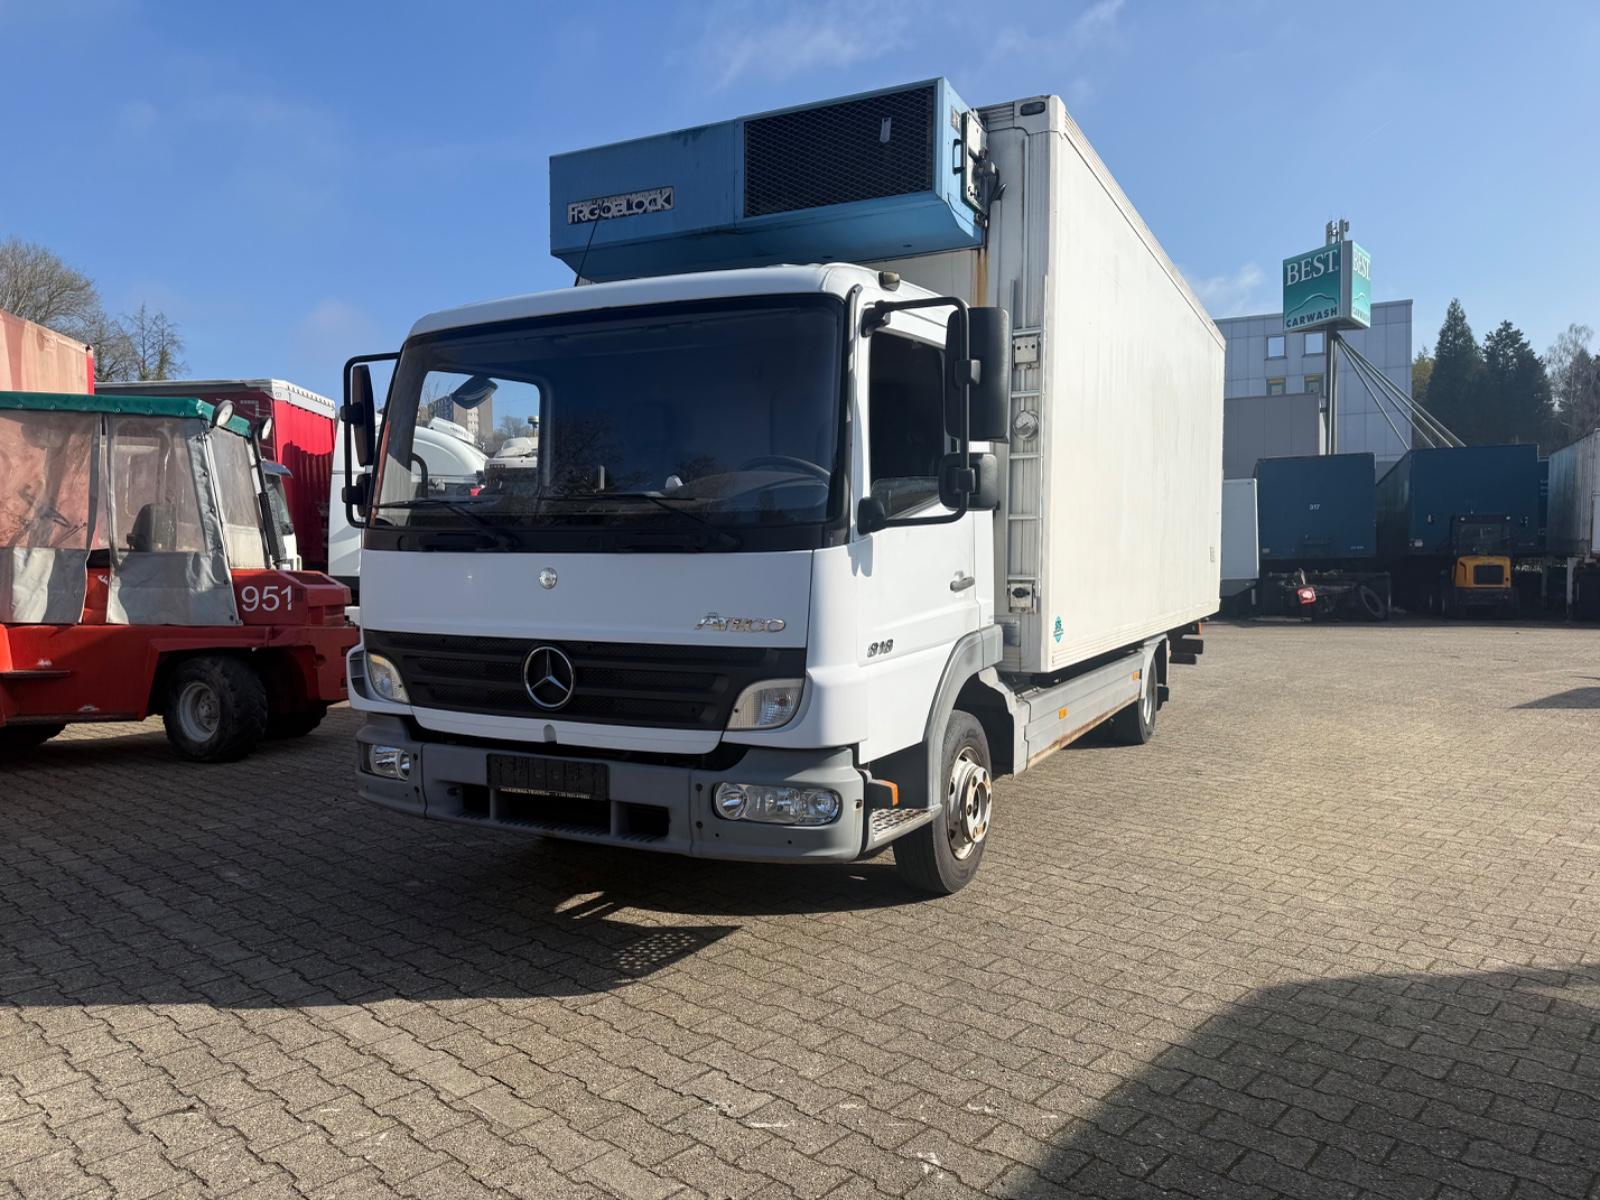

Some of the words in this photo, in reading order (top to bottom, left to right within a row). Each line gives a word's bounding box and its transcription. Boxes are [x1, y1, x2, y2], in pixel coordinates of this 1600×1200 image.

[1286, 250, 1337, 286] BEST
[1286, 307, 1337, 328] CARWASH
[241, 585, 292, 612] 951
